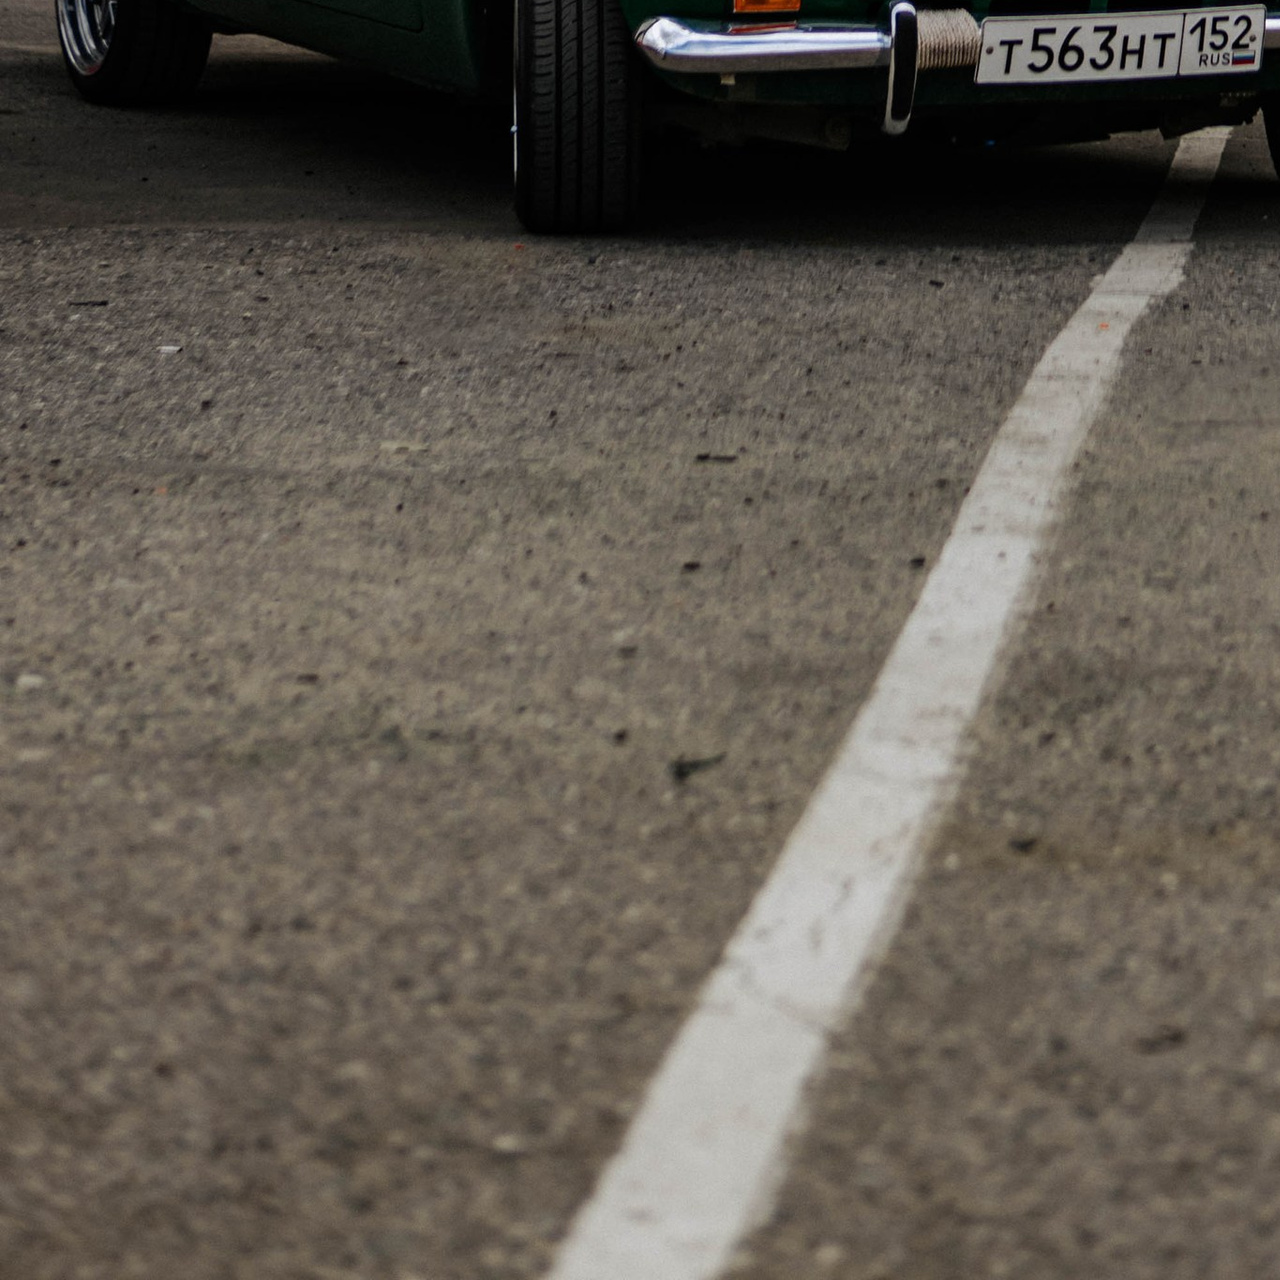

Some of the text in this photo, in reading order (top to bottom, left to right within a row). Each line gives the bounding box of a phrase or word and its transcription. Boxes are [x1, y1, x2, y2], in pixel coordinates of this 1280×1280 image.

[999, 14, 1252, 75] Т563НТ 152
[1199, 52, 1231, 68] RUS
